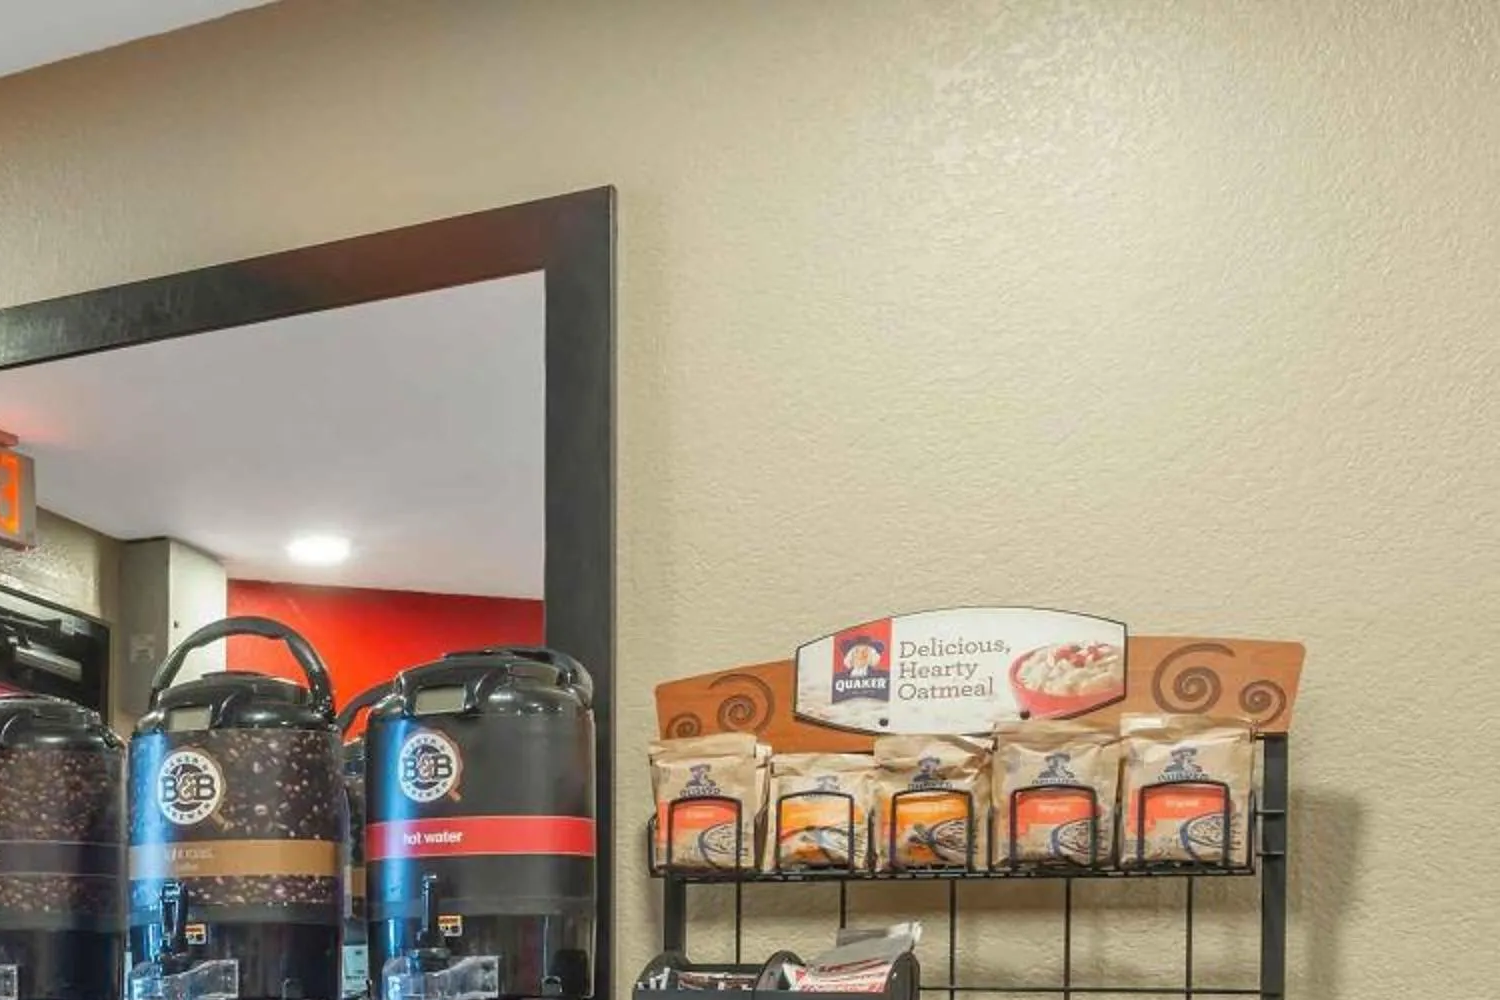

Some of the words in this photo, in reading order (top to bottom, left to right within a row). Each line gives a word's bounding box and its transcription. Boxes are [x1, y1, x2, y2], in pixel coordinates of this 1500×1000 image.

[899, 637, 1012, 660] Delicious,
[899, 660, 979, 681] Hearty
[835, 677, 888, 693] QUAKER
[897, 676, 995, 701] Oatmeal
[161, 773, 217, 802] B&B
[403, 832, 421, 846] hot
[423, 828, 463, 844] water
